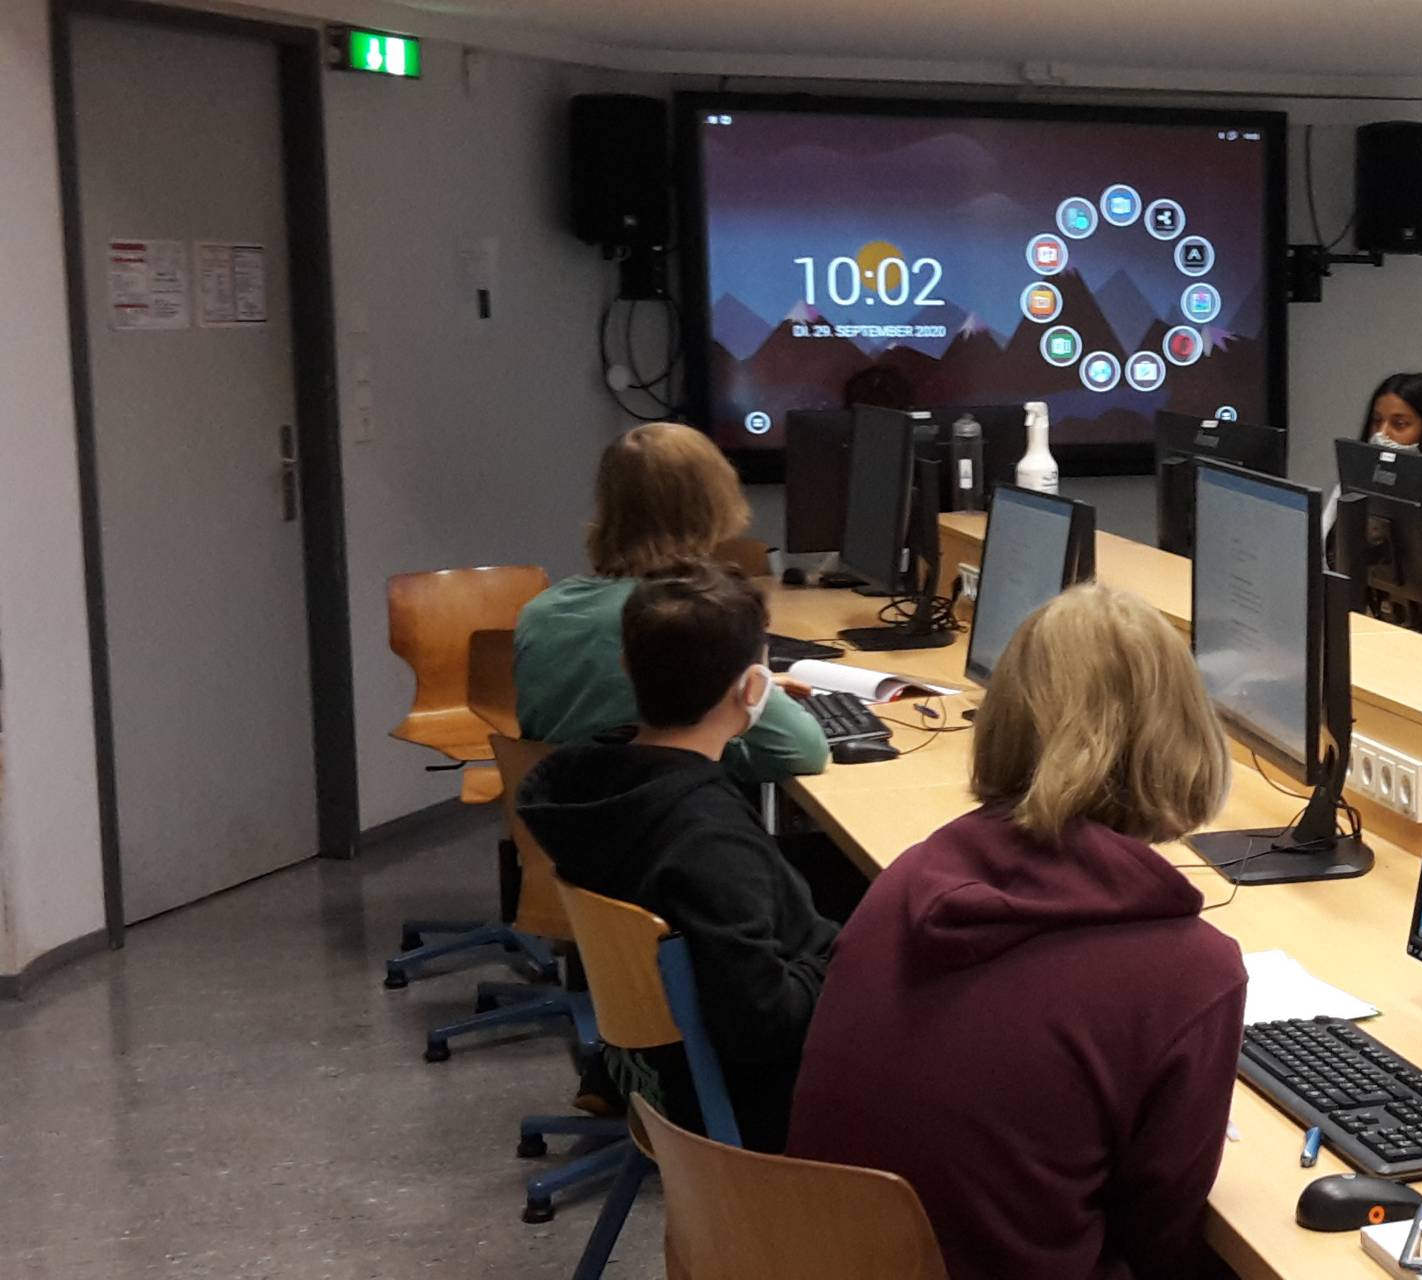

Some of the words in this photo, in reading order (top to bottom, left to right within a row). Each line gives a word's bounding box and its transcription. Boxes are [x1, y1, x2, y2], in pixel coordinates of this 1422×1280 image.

[793, 256, 945, 306] 10:02
[834, 325, 913, 338] SEPTEMBER
[914, 325, 947, 338] 2020
